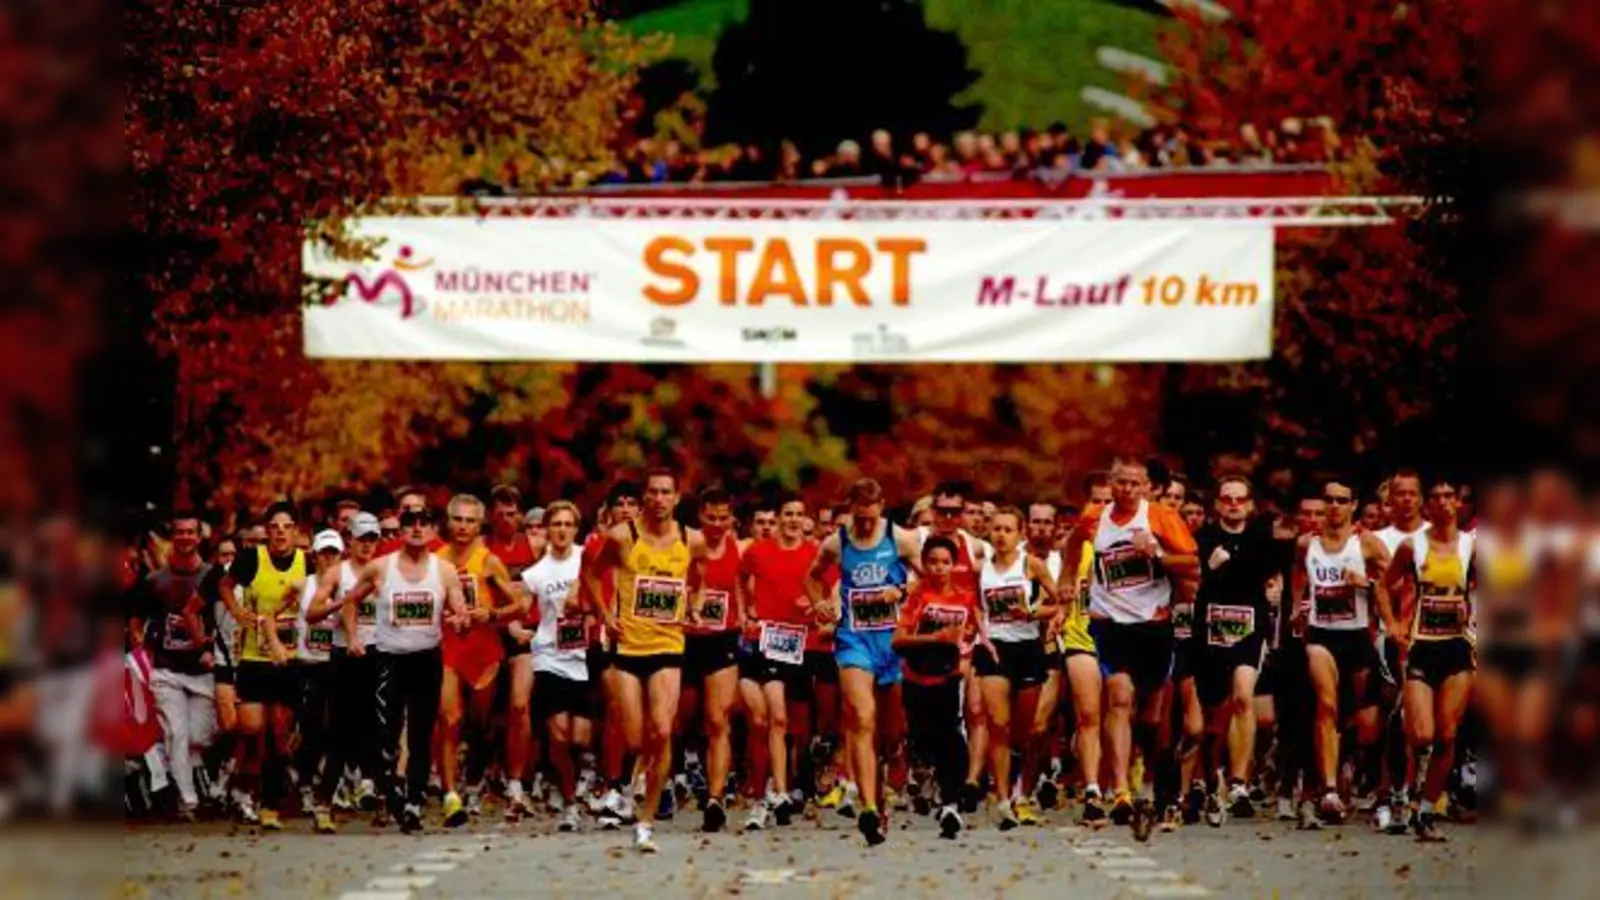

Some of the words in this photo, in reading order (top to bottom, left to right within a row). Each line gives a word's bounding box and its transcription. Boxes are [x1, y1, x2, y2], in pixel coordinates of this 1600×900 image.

[434, 266, 590, 293] MÜNCHEN
[641, 235, 927, 307] START
[976, 273, 1132, 306] M-Lauf
[1142, 275, 1186, 307] 10
[1195, 273, 1259, 306] km
[433, 298, 590, 321] MARATHON
